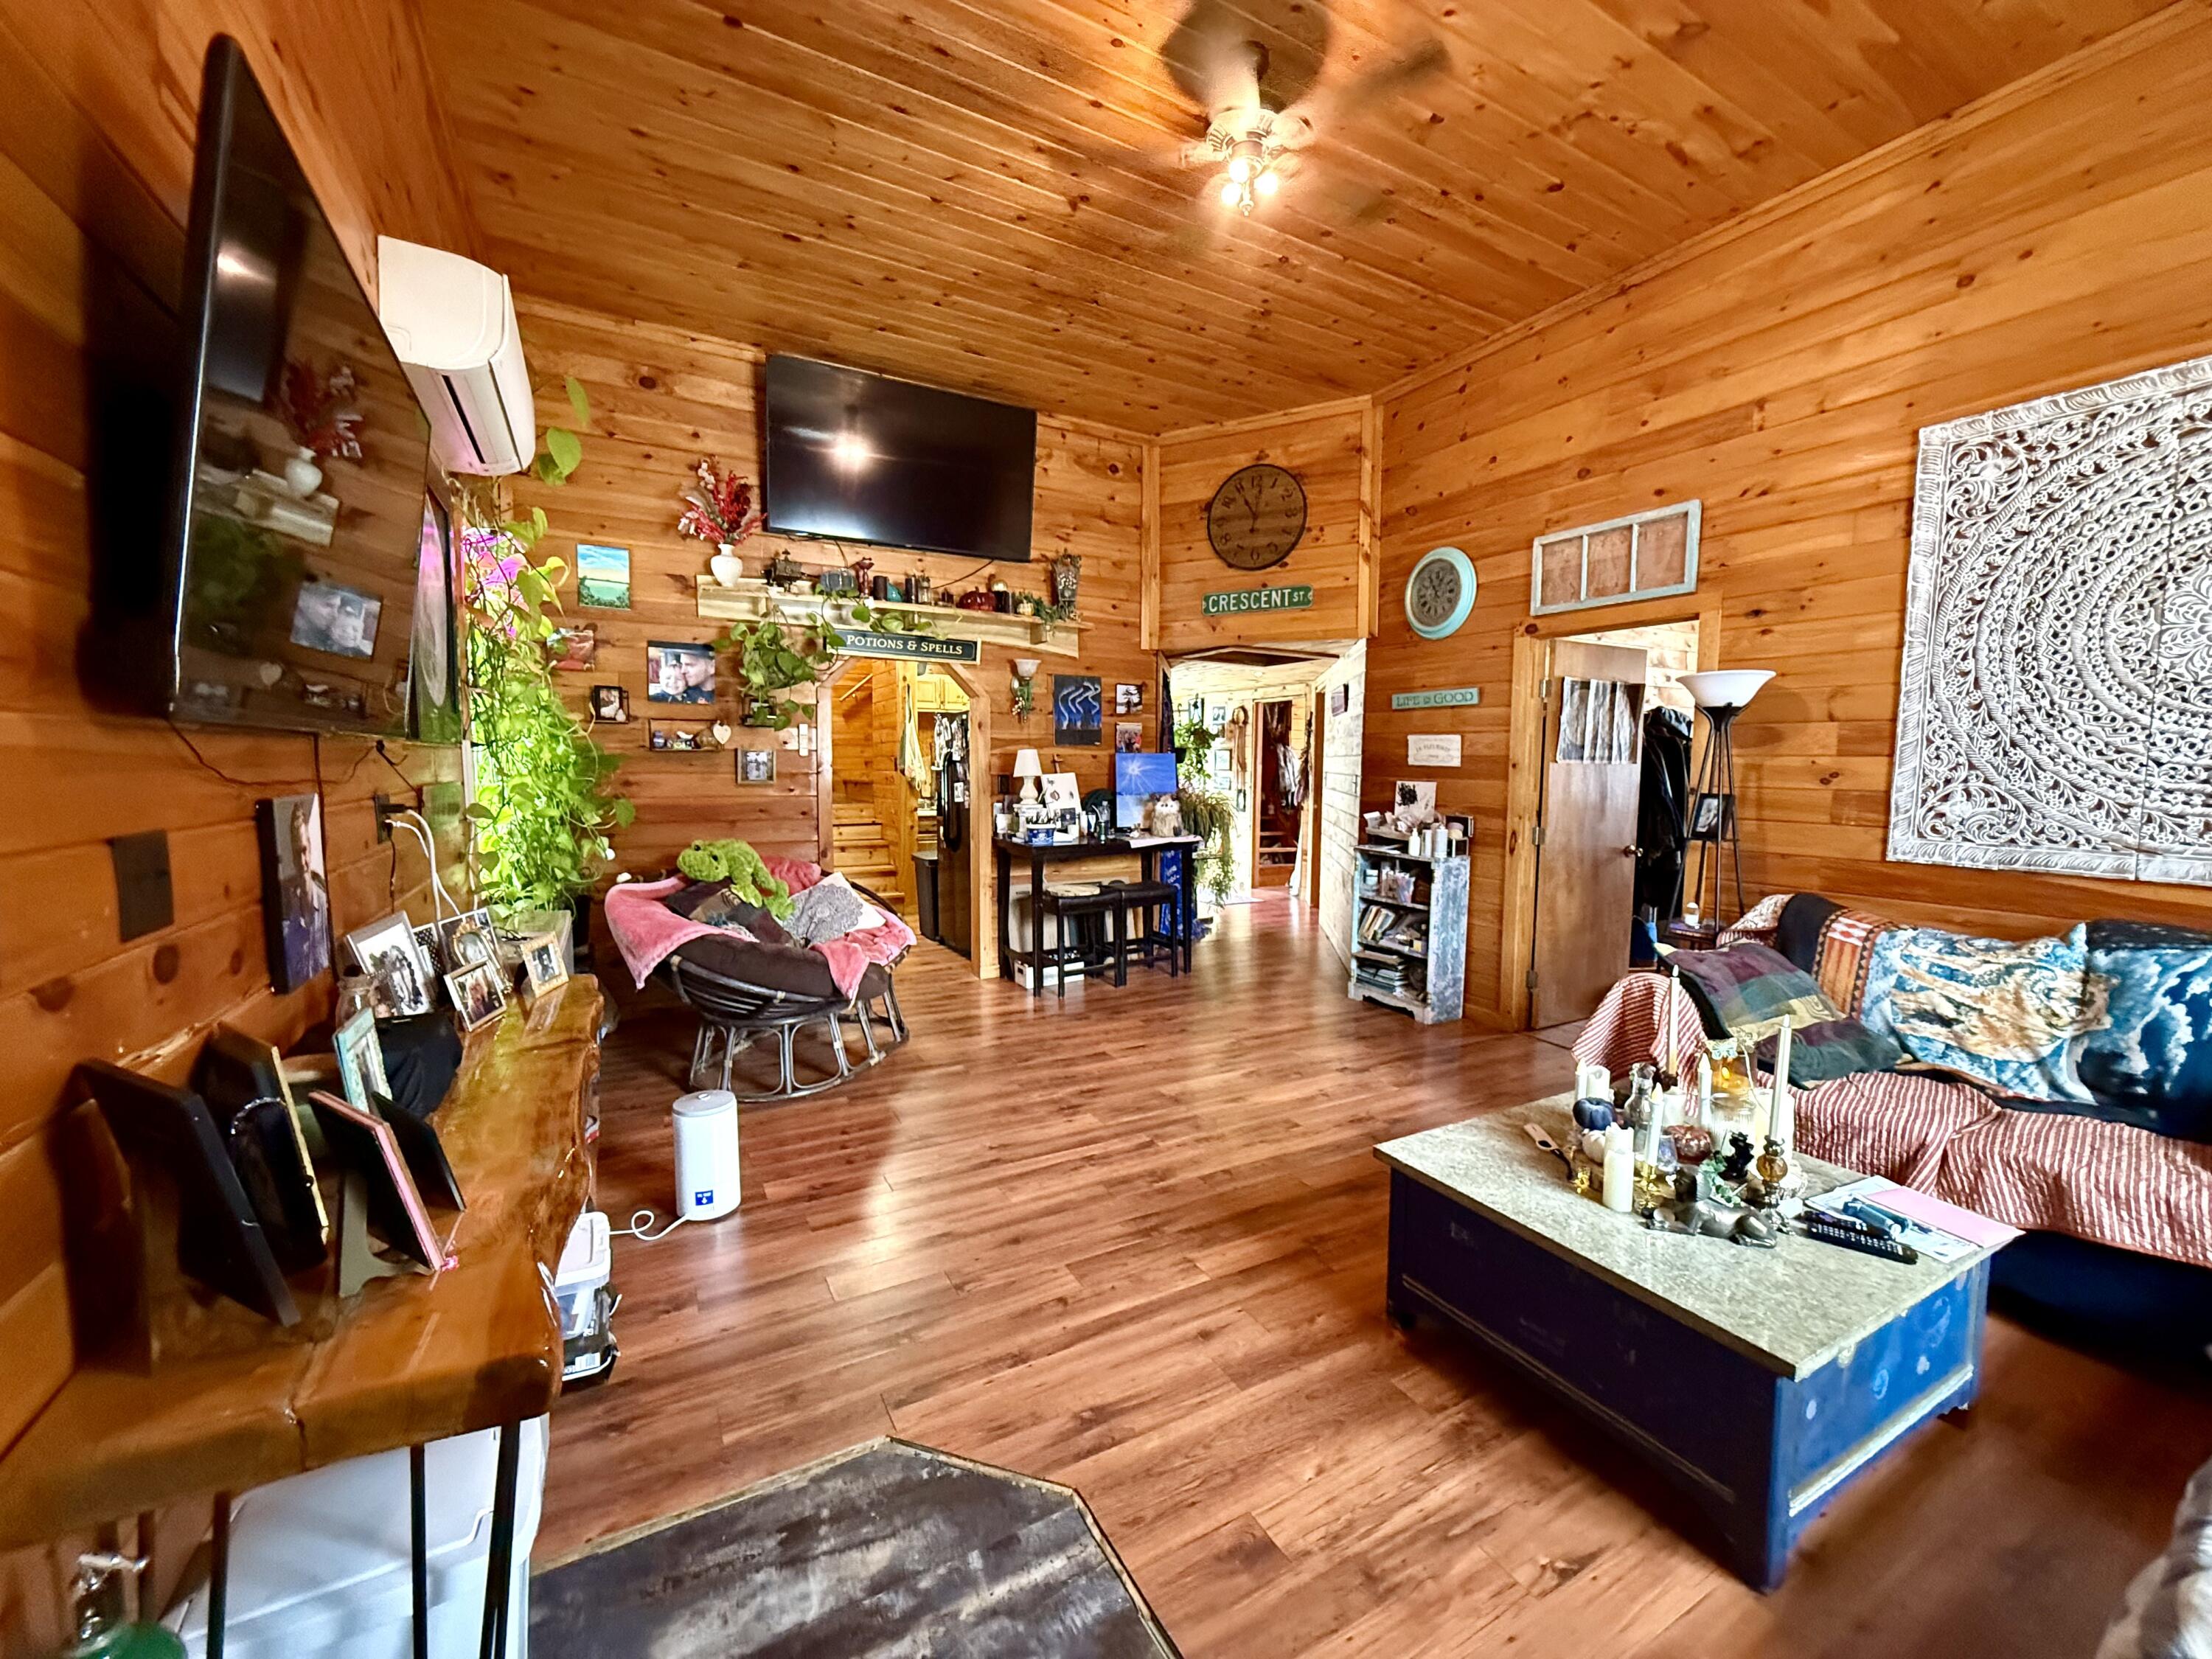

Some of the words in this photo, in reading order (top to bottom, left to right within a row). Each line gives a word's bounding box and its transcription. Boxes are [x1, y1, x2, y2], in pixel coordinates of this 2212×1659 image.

[1208, 589, 1292, 612] CRESCENT
[846, 635, 903, 650] POTIONS
[908, 640, 917, 650] &
[921, 641, 962, 655] SPELLS
[1397, 695, 1420, 707] LIFE
[1434, 691, 1474, 704] GOOD
